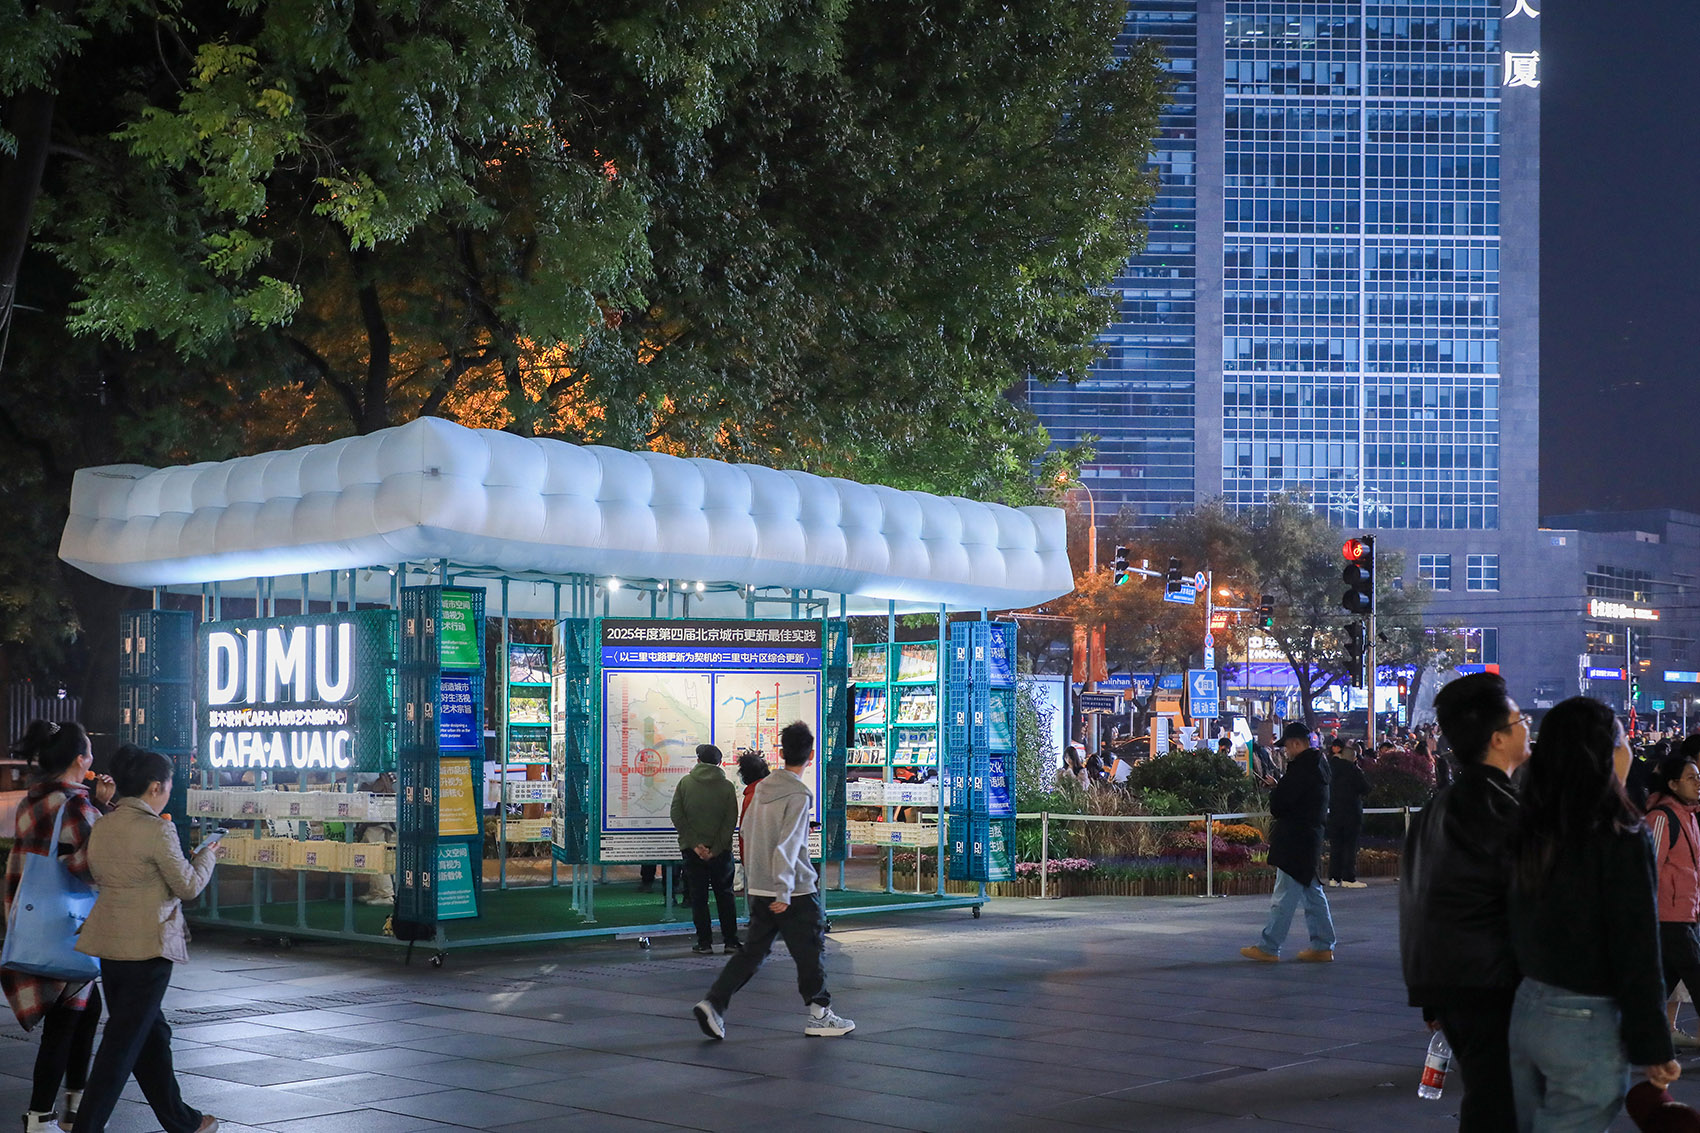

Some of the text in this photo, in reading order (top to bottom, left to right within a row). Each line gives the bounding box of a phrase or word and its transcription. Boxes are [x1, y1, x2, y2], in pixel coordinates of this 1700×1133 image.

[607, 627, 816, 643] 2025年度第四届北京城市更新最佳实践
[208, 623, 351, 705] DIMU
[1132, 675, 1150, 686] Bank
[440, 704, 472, 714] 艺术宗旨
[1193, 701, 1217, 714] 机动车
[209, 730, 350, 769] CAFA·A UAIC
